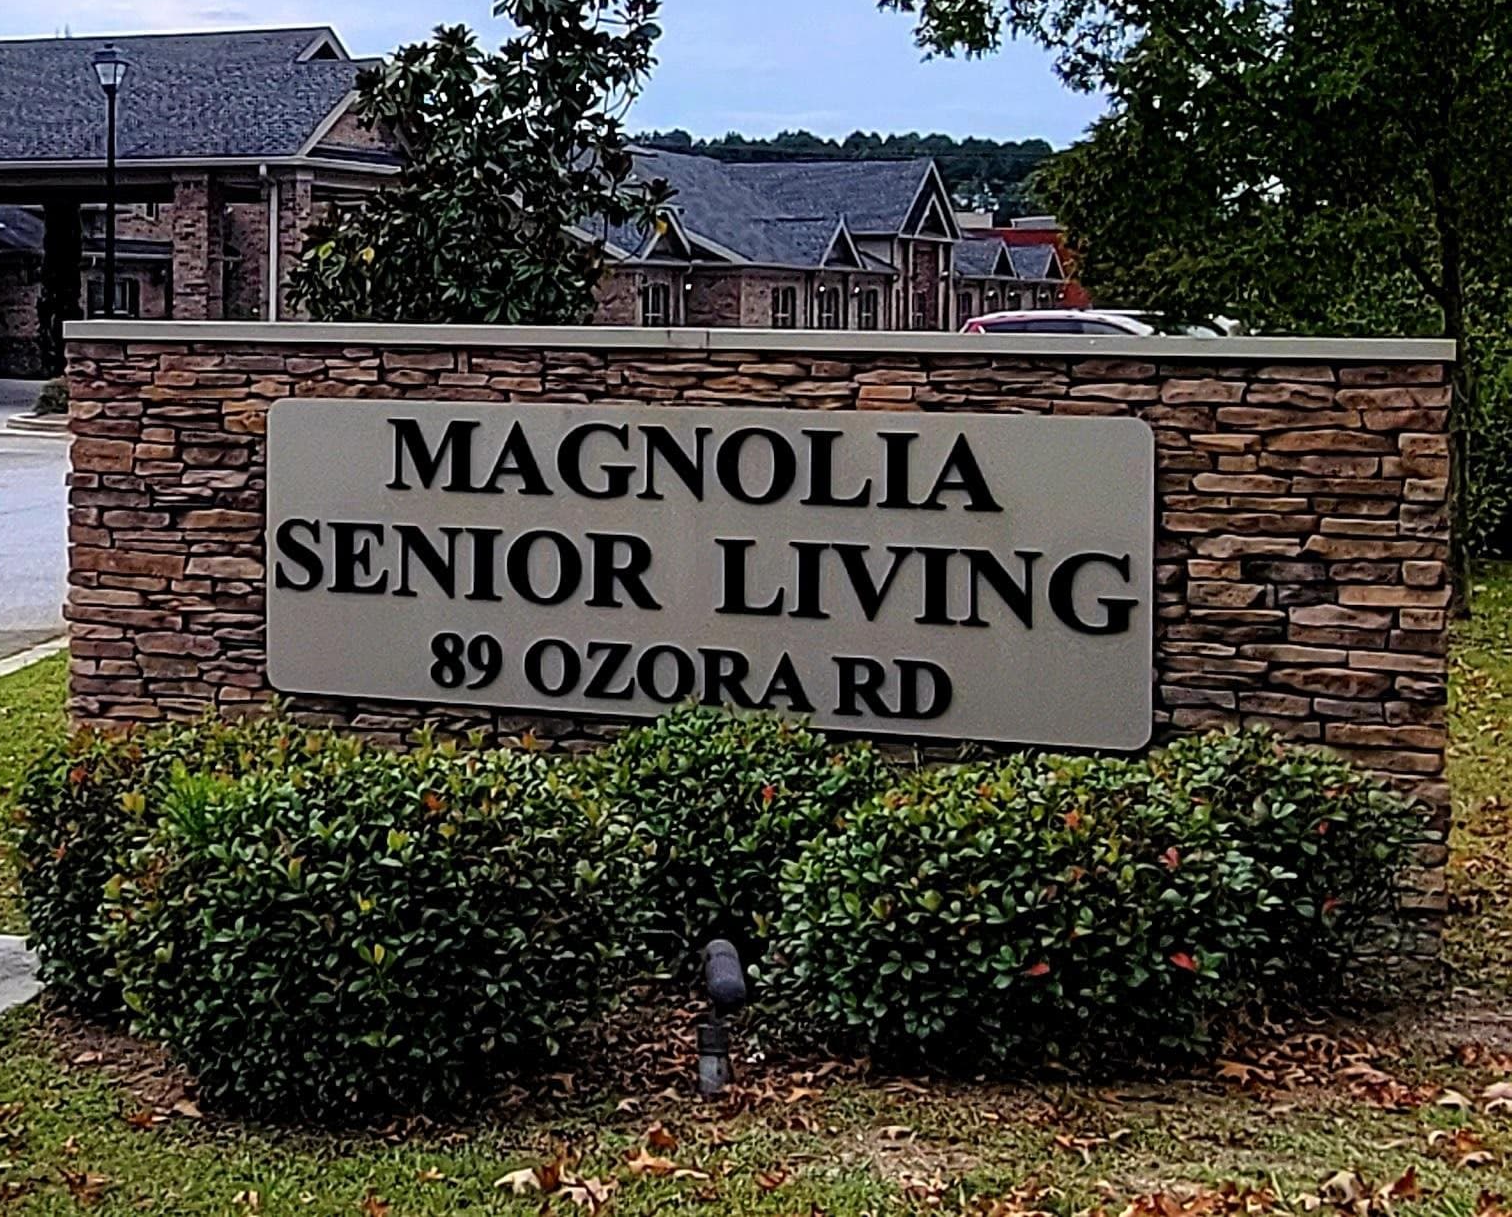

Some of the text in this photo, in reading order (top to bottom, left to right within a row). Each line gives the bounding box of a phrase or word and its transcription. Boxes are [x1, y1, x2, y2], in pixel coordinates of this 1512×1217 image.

[385, 417, 1005, 514] MAGNOLIA
[274, 517, 1141, 638] SENIOR LIVING
[429, 631, 955, 723] 89 OZORA RD
